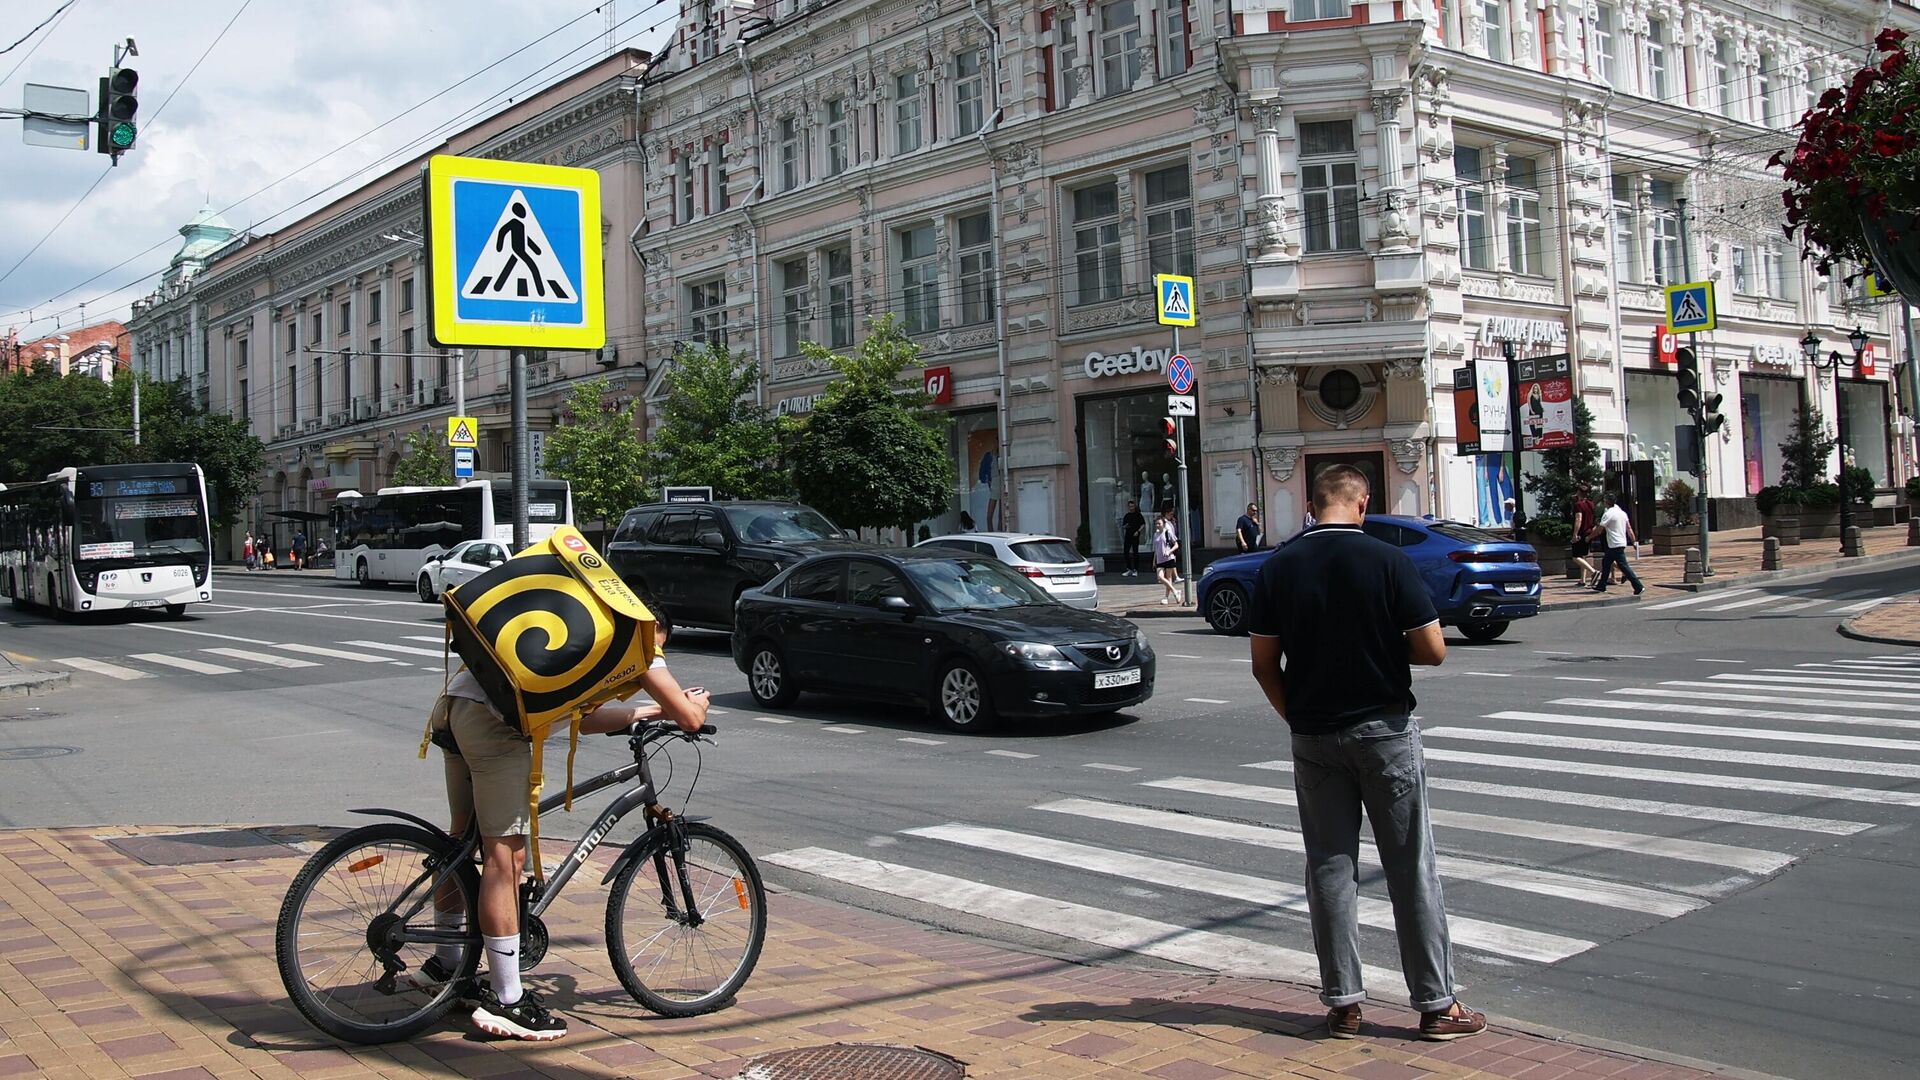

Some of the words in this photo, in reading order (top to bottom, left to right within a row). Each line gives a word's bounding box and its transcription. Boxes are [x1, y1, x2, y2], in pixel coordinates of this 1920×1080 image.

[1481, 316, 1527, 347] GLORIA
[1661, 334, 1677, 354] GJ
[1756, 342, 1801, 370] GeeJay
[1084, 345, 1171, 379] GeeJay
[1862, 350, 1873, 367] GJ
[927, 375, 945, 396] GJ
[598, 578, 616, 596] Еда
[610, 578, 639, 607] Яндекс
